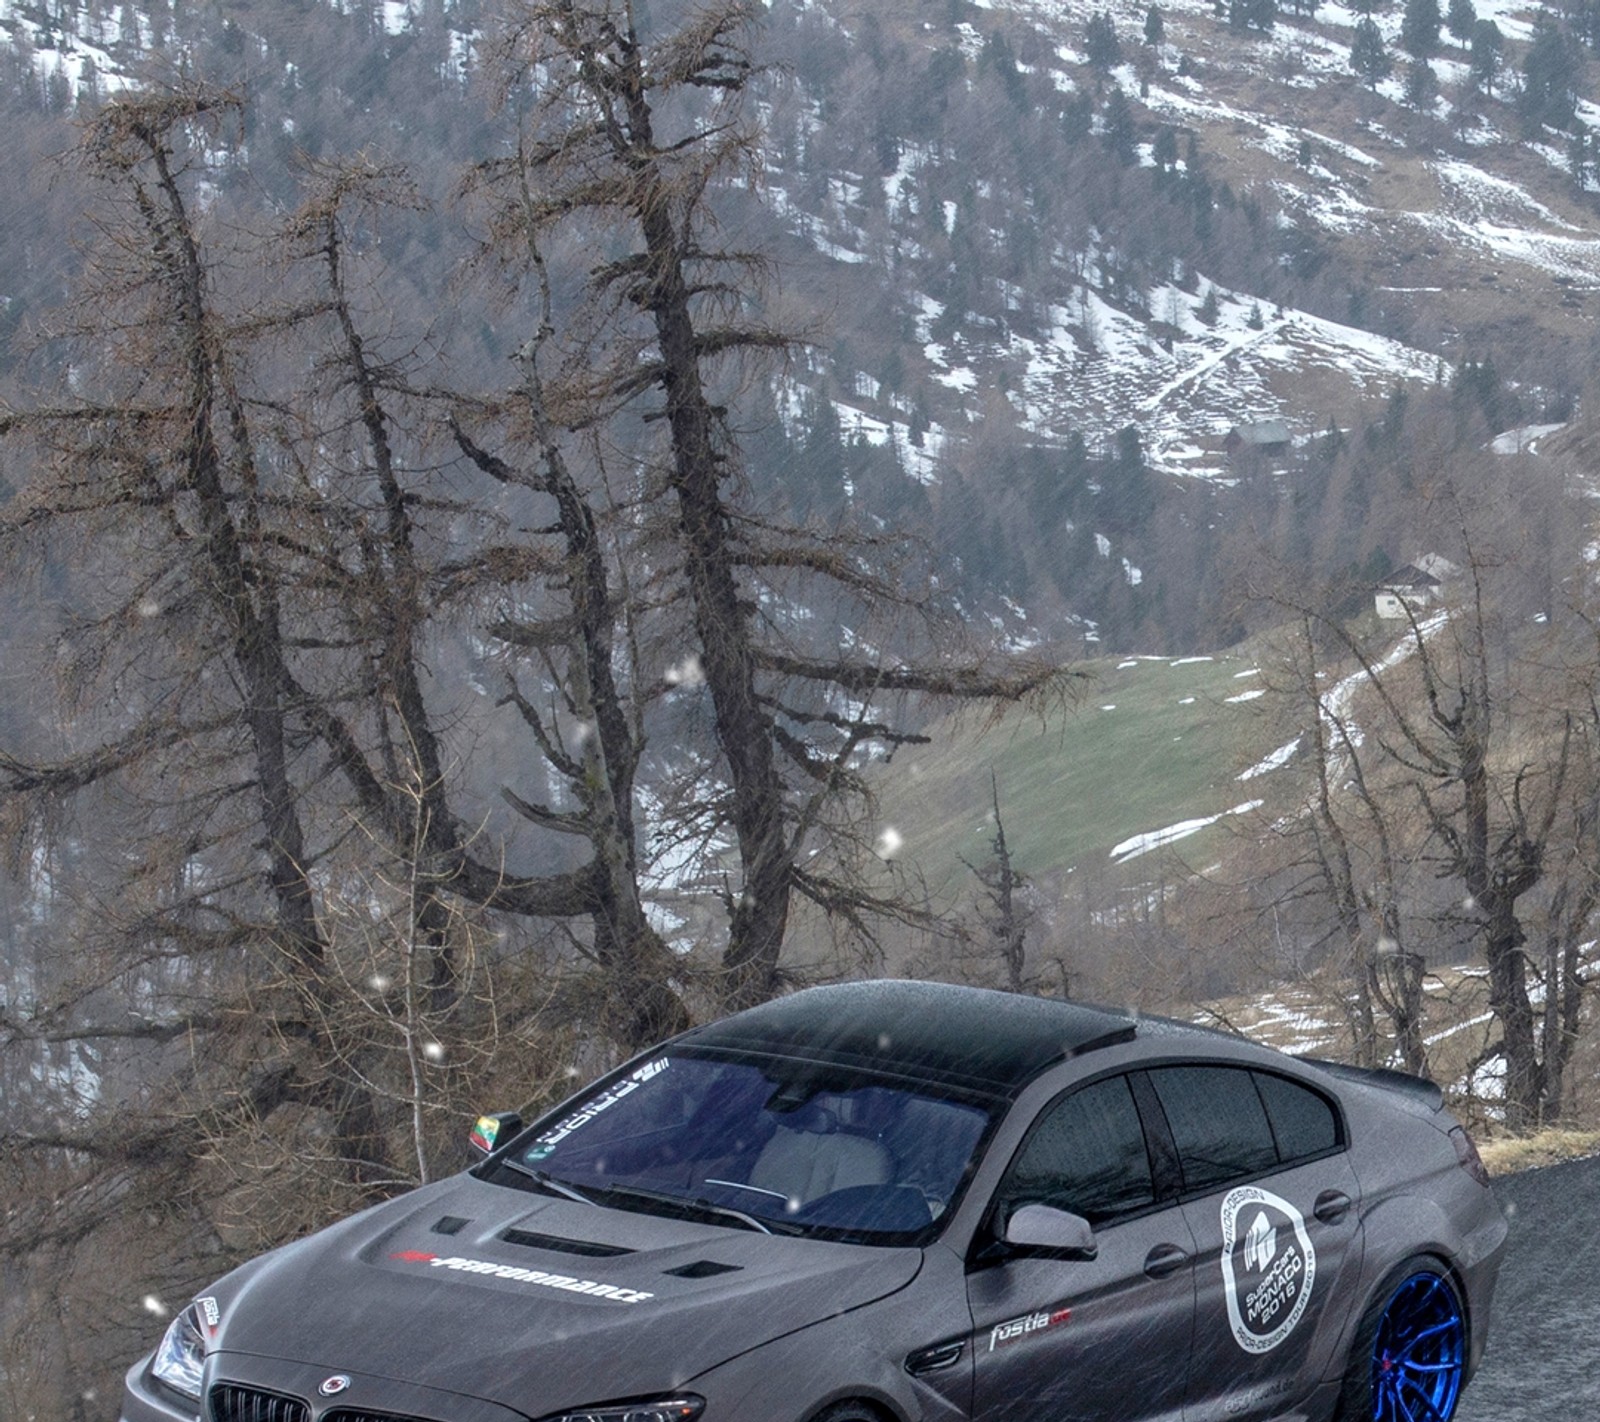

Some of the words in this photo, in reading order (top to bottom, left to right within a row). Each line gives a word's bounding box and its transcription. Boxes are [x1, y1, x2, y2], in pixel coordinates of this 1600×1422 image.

[1246, 1246, 1296, 1307] SuperCars
[1248, 1256, 1301, 1321] MONACO
[1262, 1282, 1296, 1324] 2016
[1289, 1293, 1309, 1326] TOUR
